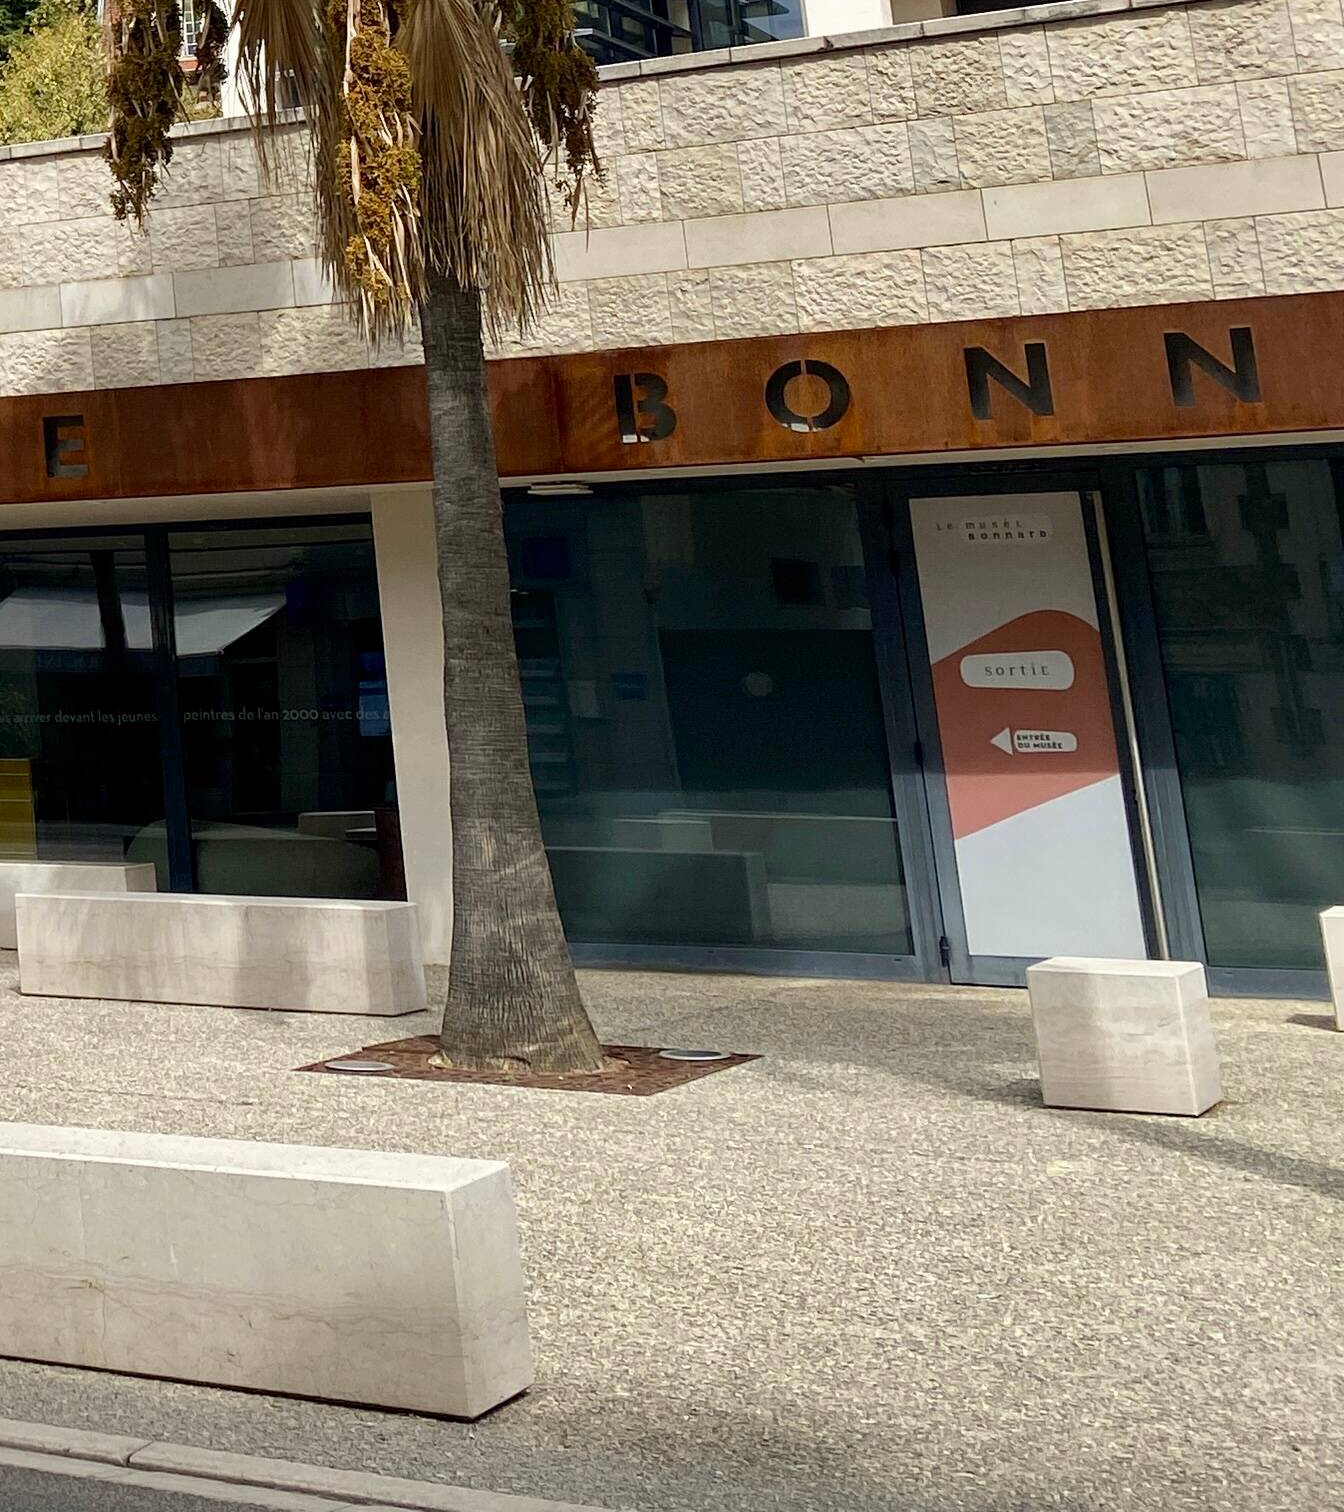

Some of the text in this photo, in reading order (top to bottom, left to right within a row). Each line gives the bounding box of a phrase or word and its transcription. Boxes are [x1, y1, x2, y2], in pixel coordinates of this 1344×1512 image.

[614, 326, 1264, 445] BONN
[55, 709, 95, 723] devant
[98, 709, 115, 723] les
[116, 710, 158, 726] jeunes
[183, 709, 236, 723] peintres
[238, 706, 255, 721] de
[281, 709, 319, 721] 2000
[321, 709, 353, 721] avec
